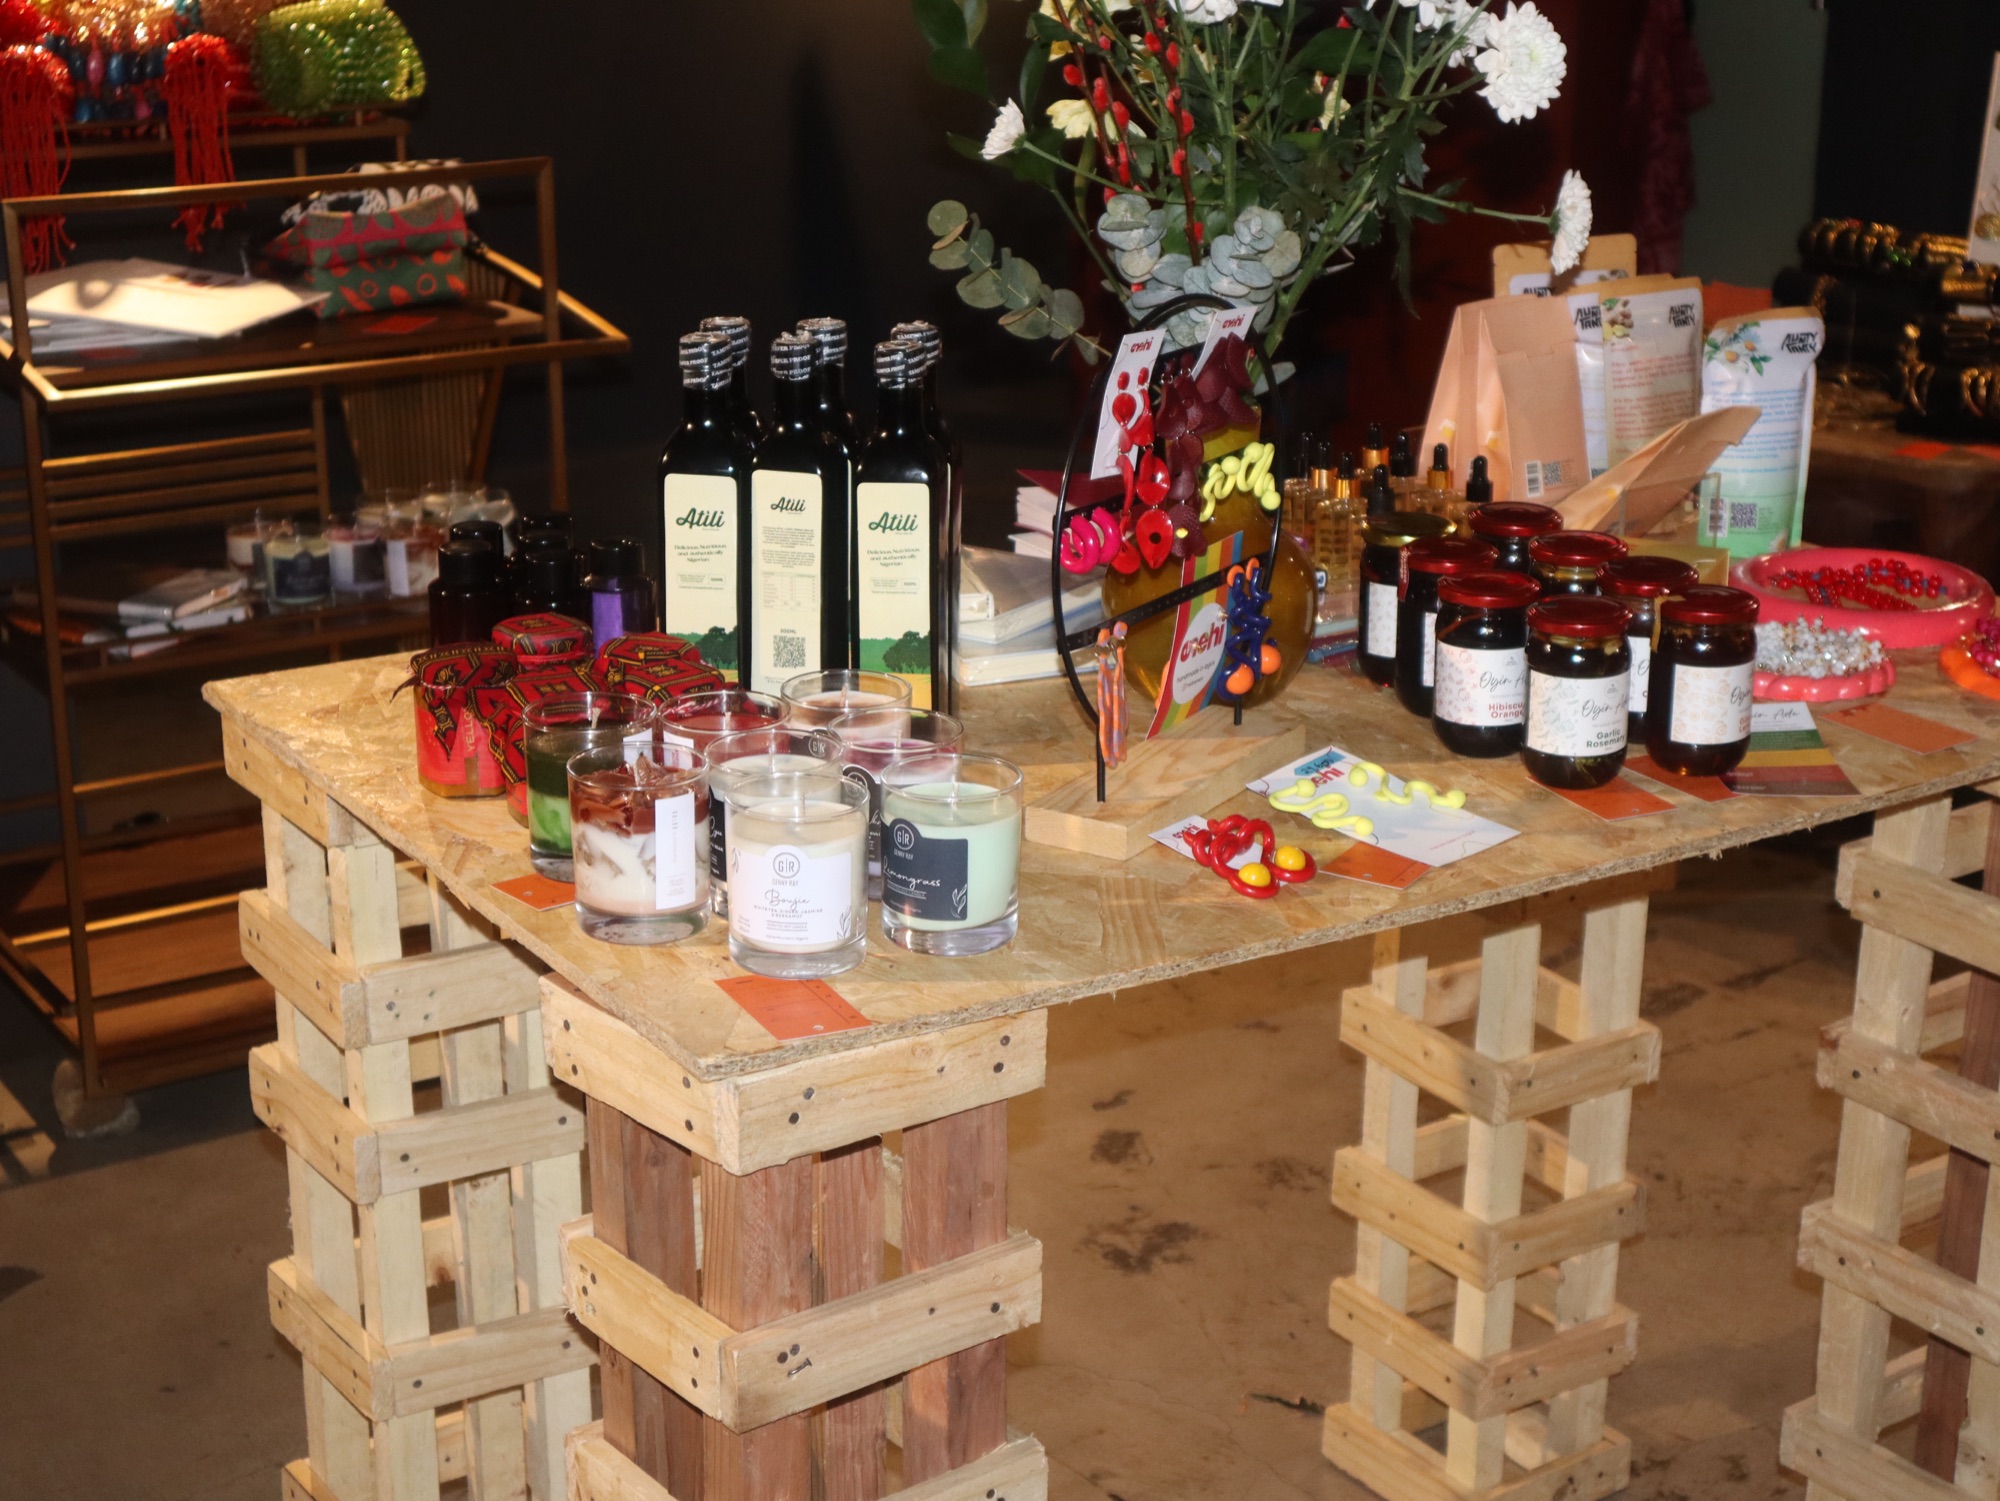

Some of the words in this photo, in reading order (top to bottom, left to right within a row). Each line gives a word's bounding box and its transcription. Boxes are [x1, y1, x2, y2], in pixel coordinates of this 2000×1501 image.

[770, 496, 806, 513] Atili
[676, 507, 725, 529] Atili
[868, 512, 918, 534] Atili
[1479, 670, 1512, 693] Oyin
[1581, 699, 1614, 720] Oyin
[463, 711, 475, 752] YELLO
[1586, 734, 1626, 749] Rosemary
[1596, 728, 1621, 740] Garlic
